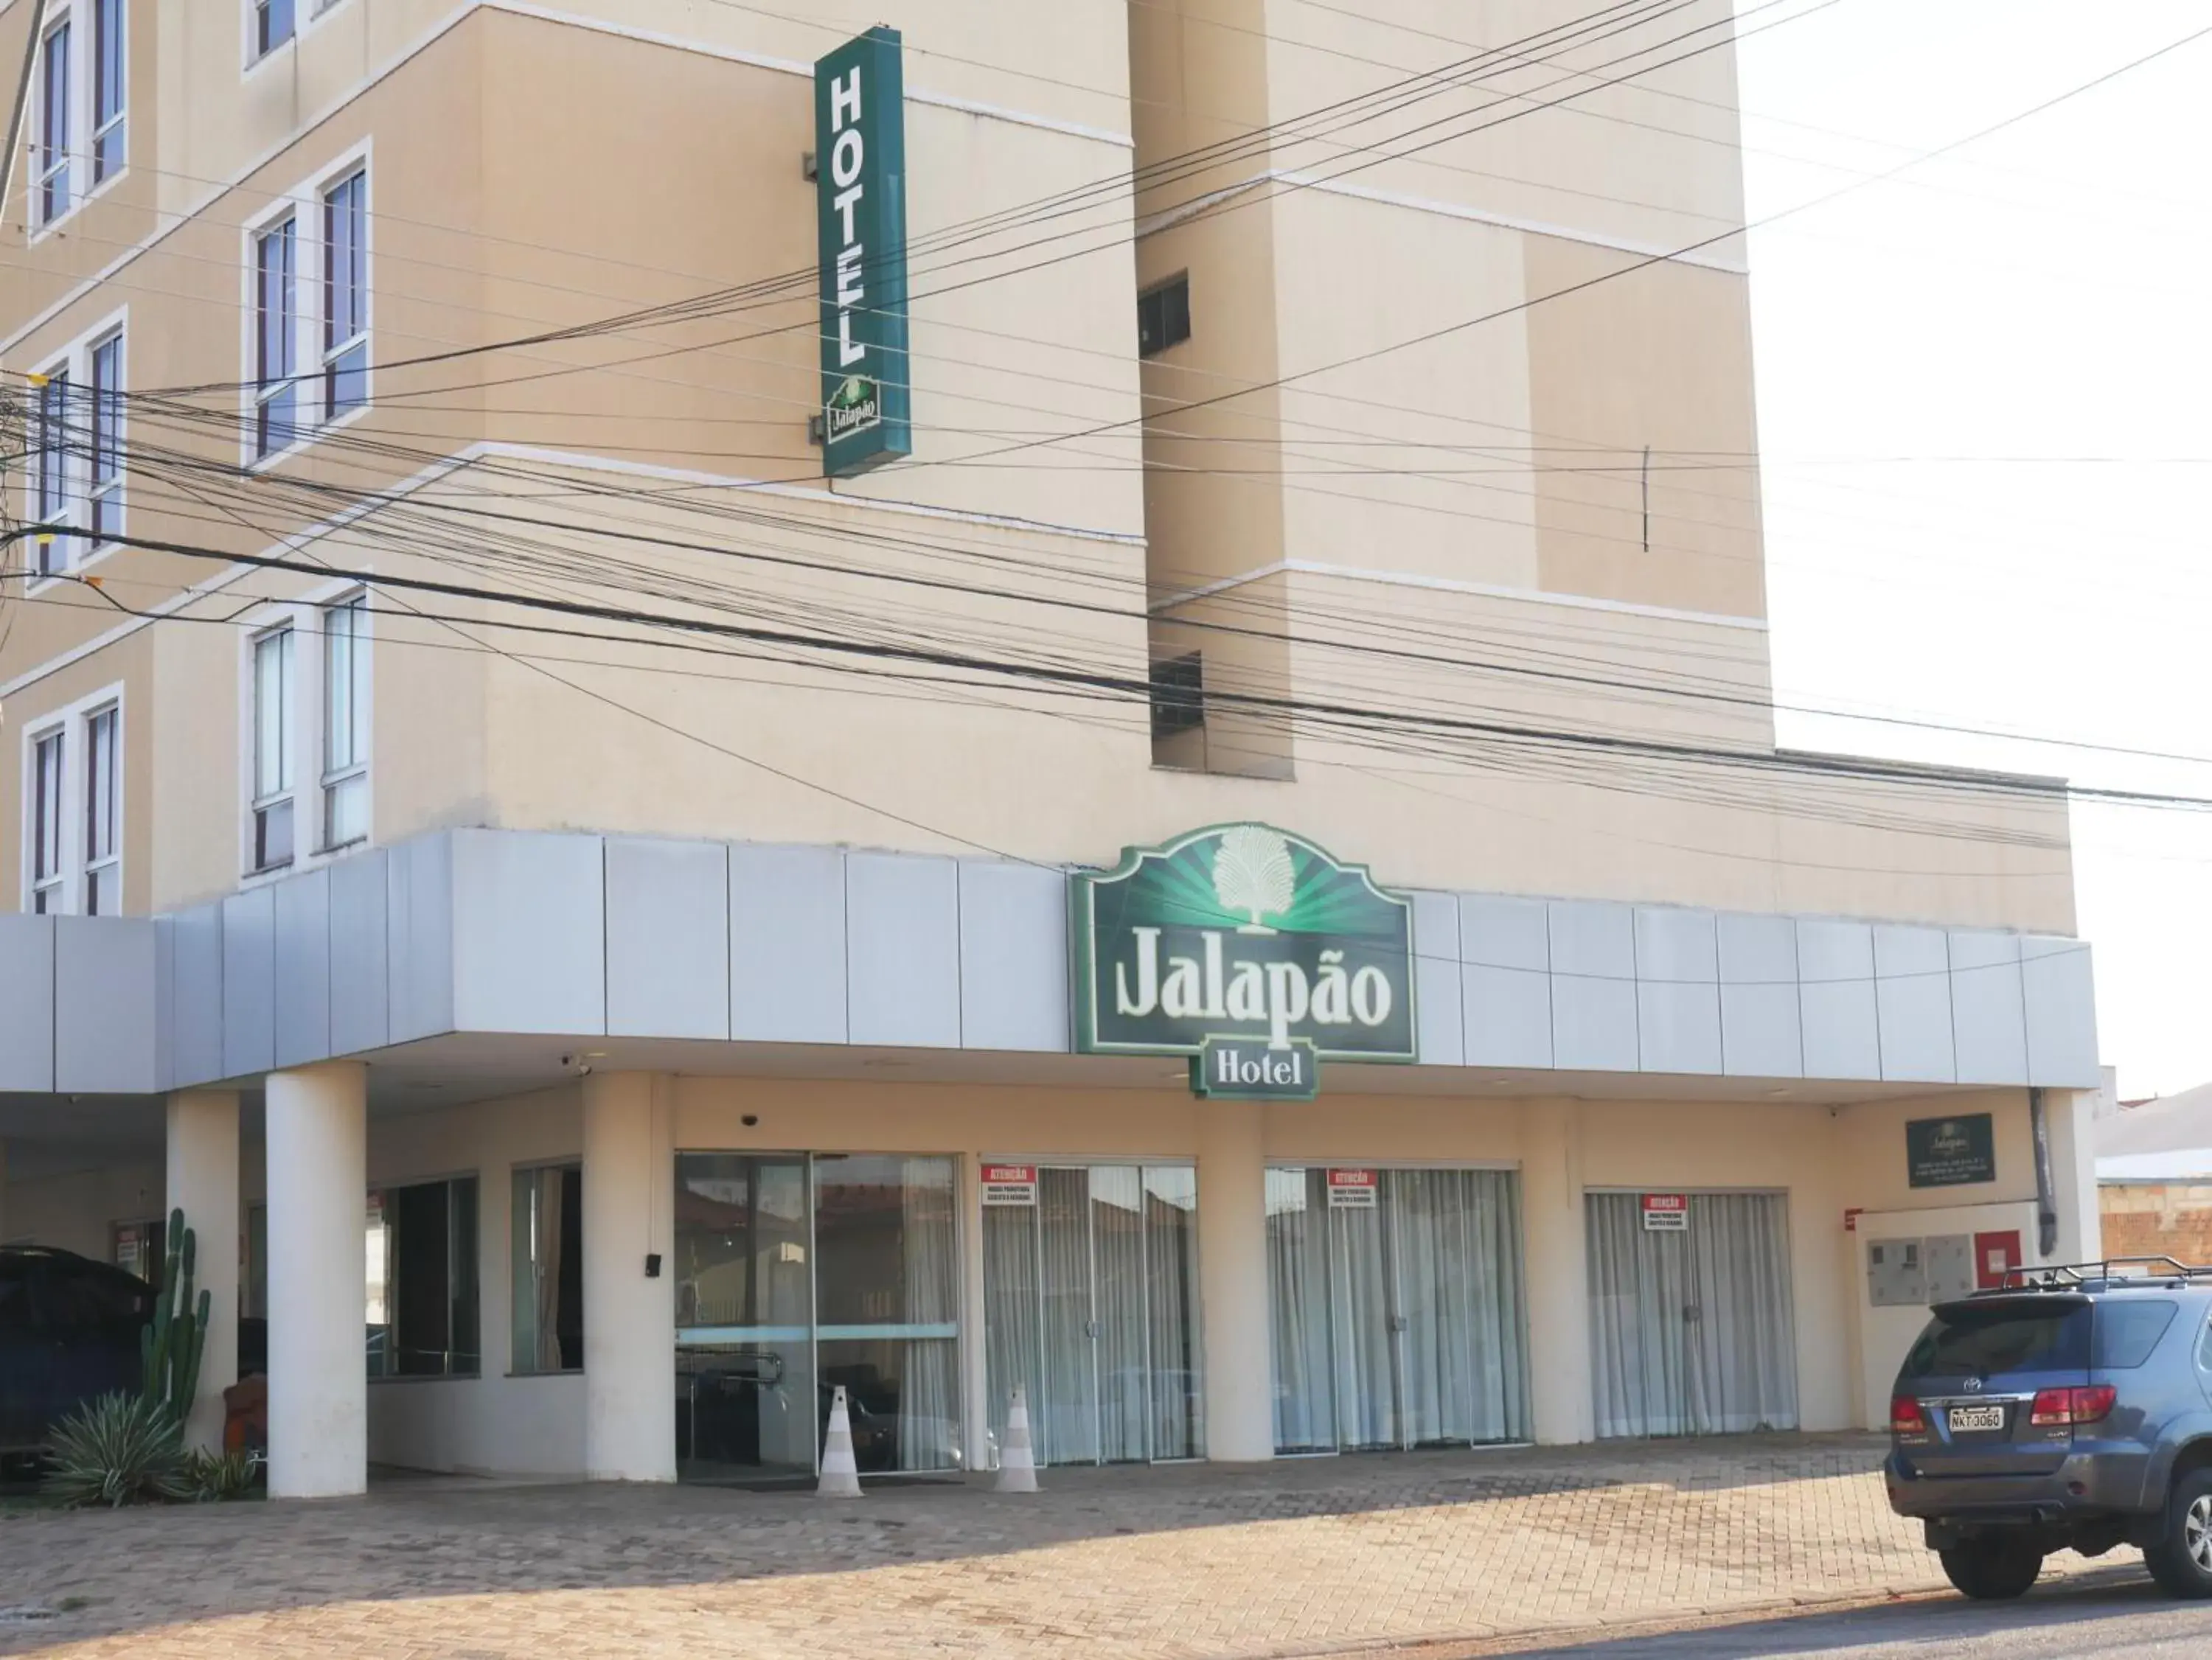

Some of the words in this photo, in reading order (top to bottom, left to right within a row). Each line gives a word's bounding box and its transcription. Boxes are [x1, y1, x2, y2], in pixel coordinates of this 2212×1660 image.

[831, 66, 865, 367] HOTEL
[1116, 926, 1392, 1050] Jalapão
[1217, 1049, 1303, 1085] Hotel
[990, 1166, 1027, 1181] ATENÇÃO
